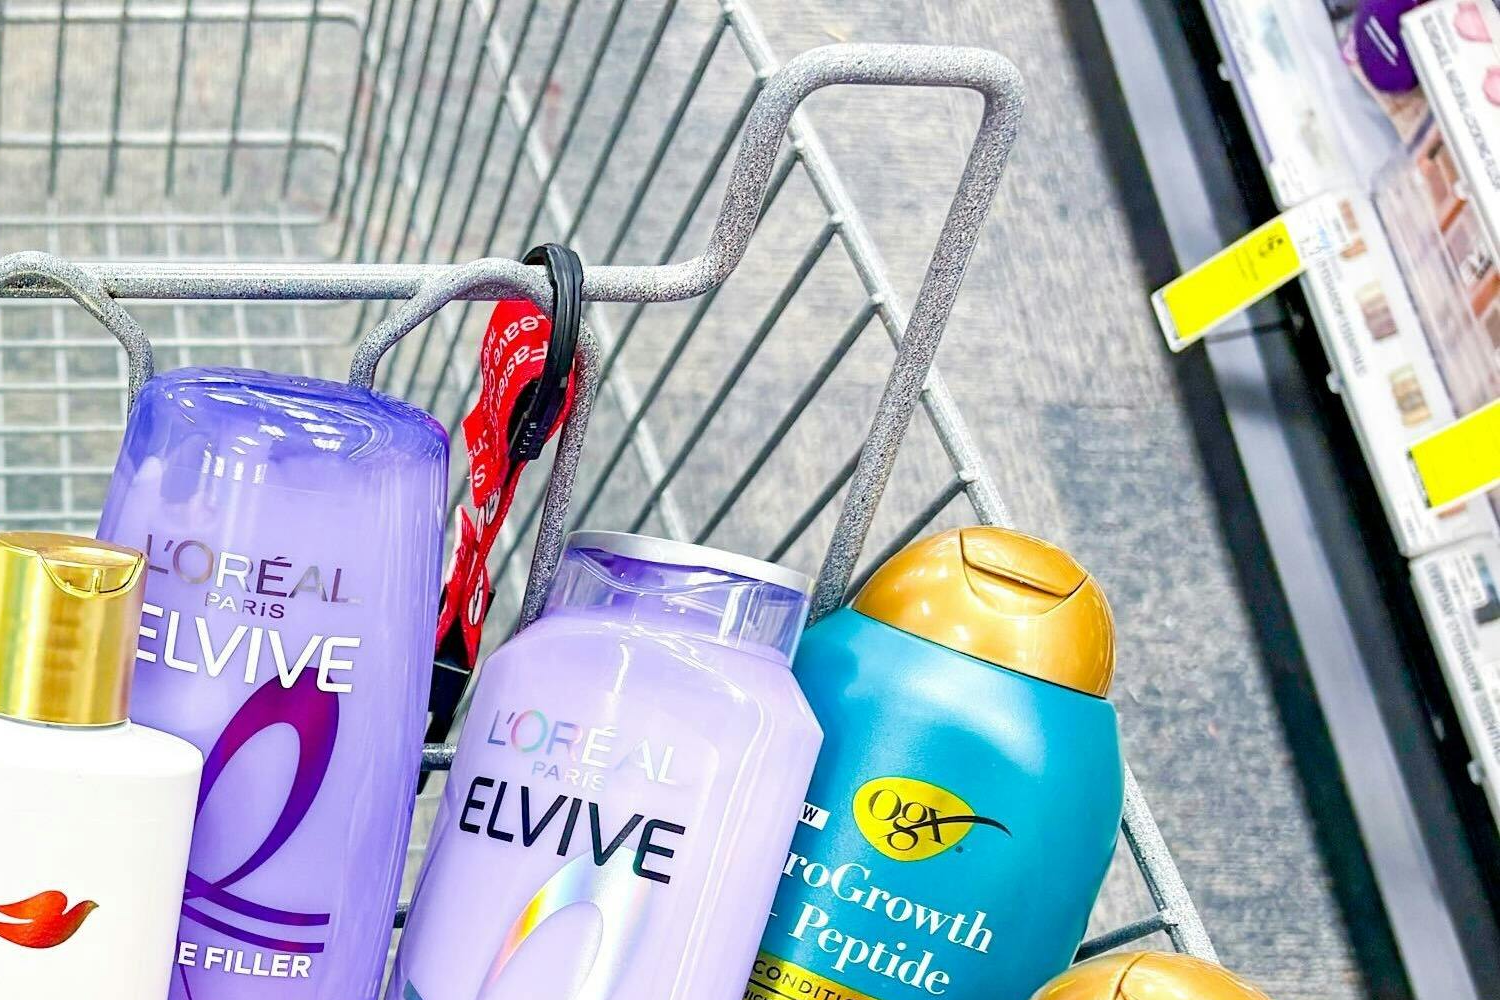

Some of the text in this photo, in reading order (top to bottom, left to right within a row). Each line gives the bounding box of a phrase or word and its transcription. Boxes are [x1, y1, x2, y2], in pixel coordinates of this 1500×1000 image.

[146, 533, 360, 604] L'ORÉAL
[136, 602, 362, 693] ELVIVE
[531, 761, 606, 792] PARIS
[459, 776, 687, 884] ELVIVE
[781, 850, 996, 955] roGrowth
[788, 901, 950, 995] Peptide
[204, 945, 313, 979] FILLER
